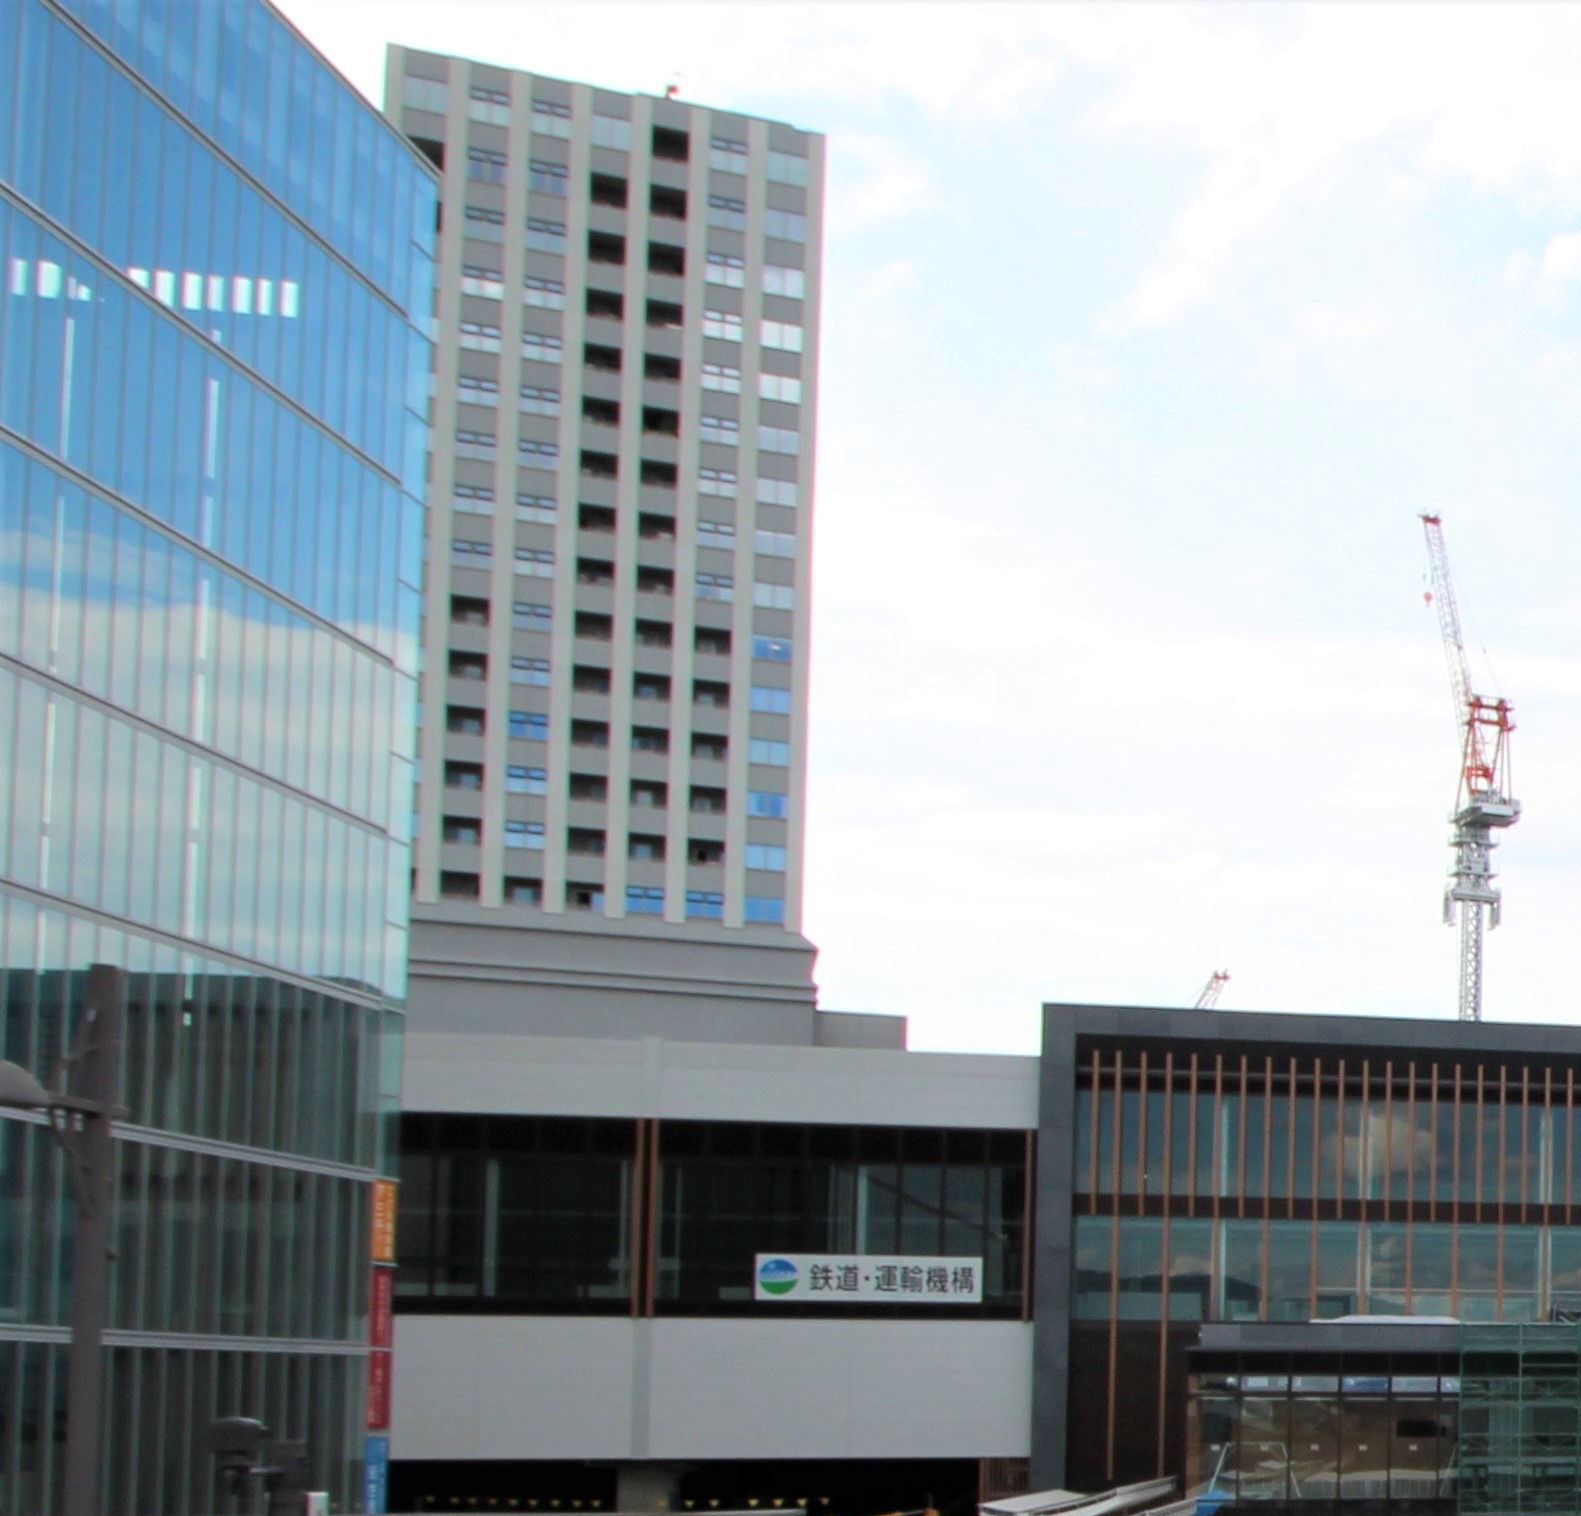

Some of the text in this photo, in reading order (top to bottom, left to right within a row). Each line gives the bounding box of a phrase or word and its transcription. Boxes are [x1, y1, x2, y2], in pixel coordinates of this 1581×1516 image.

[809, 1264, 974, 1294] 鉄道・運輸機構
